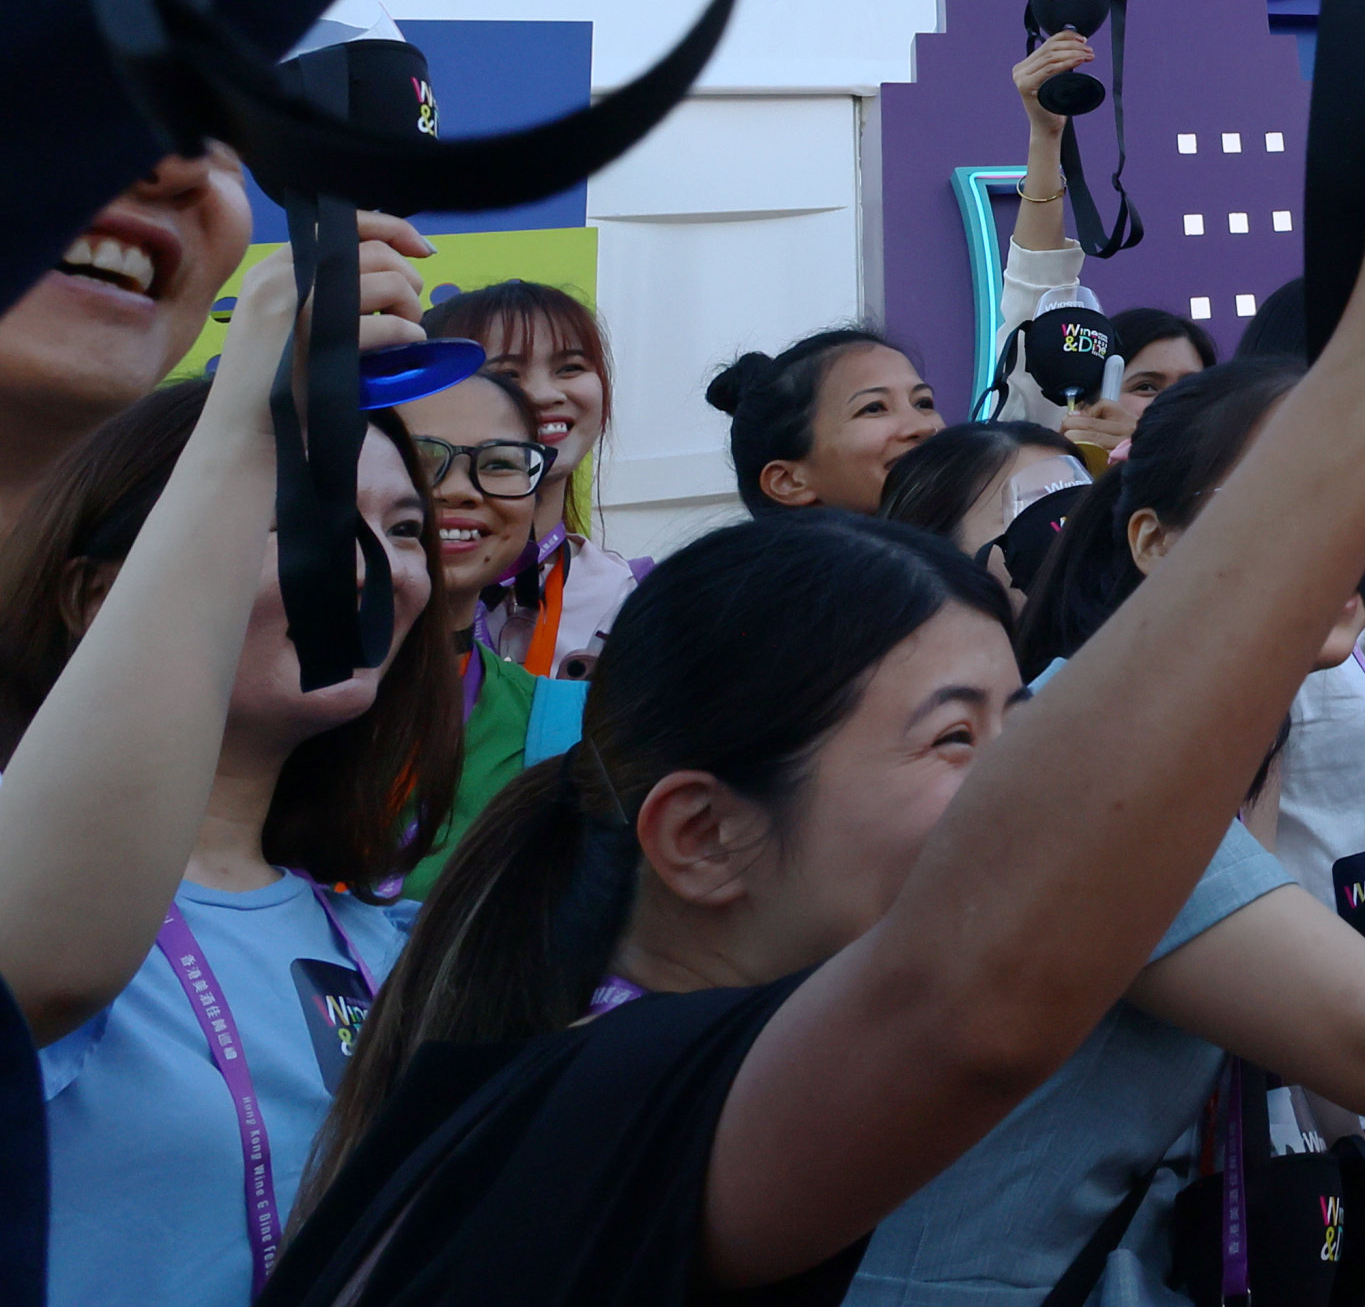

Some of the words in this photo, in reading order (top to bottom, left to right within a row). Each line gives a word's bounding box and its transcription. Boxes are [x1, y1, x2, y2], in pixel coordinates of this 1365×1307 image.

[1061, 323, 1099, 340] Wine
[1063, 335, 1078, 352] &
[1078, 335, 1106, 356] Dine
[250, 1129, 263, 1161] Kong
[254, 1164, 266, 1197] Wine
[259, 1212, 273, 1243] Dine
[1321, 1226, 1338, 1262] &
